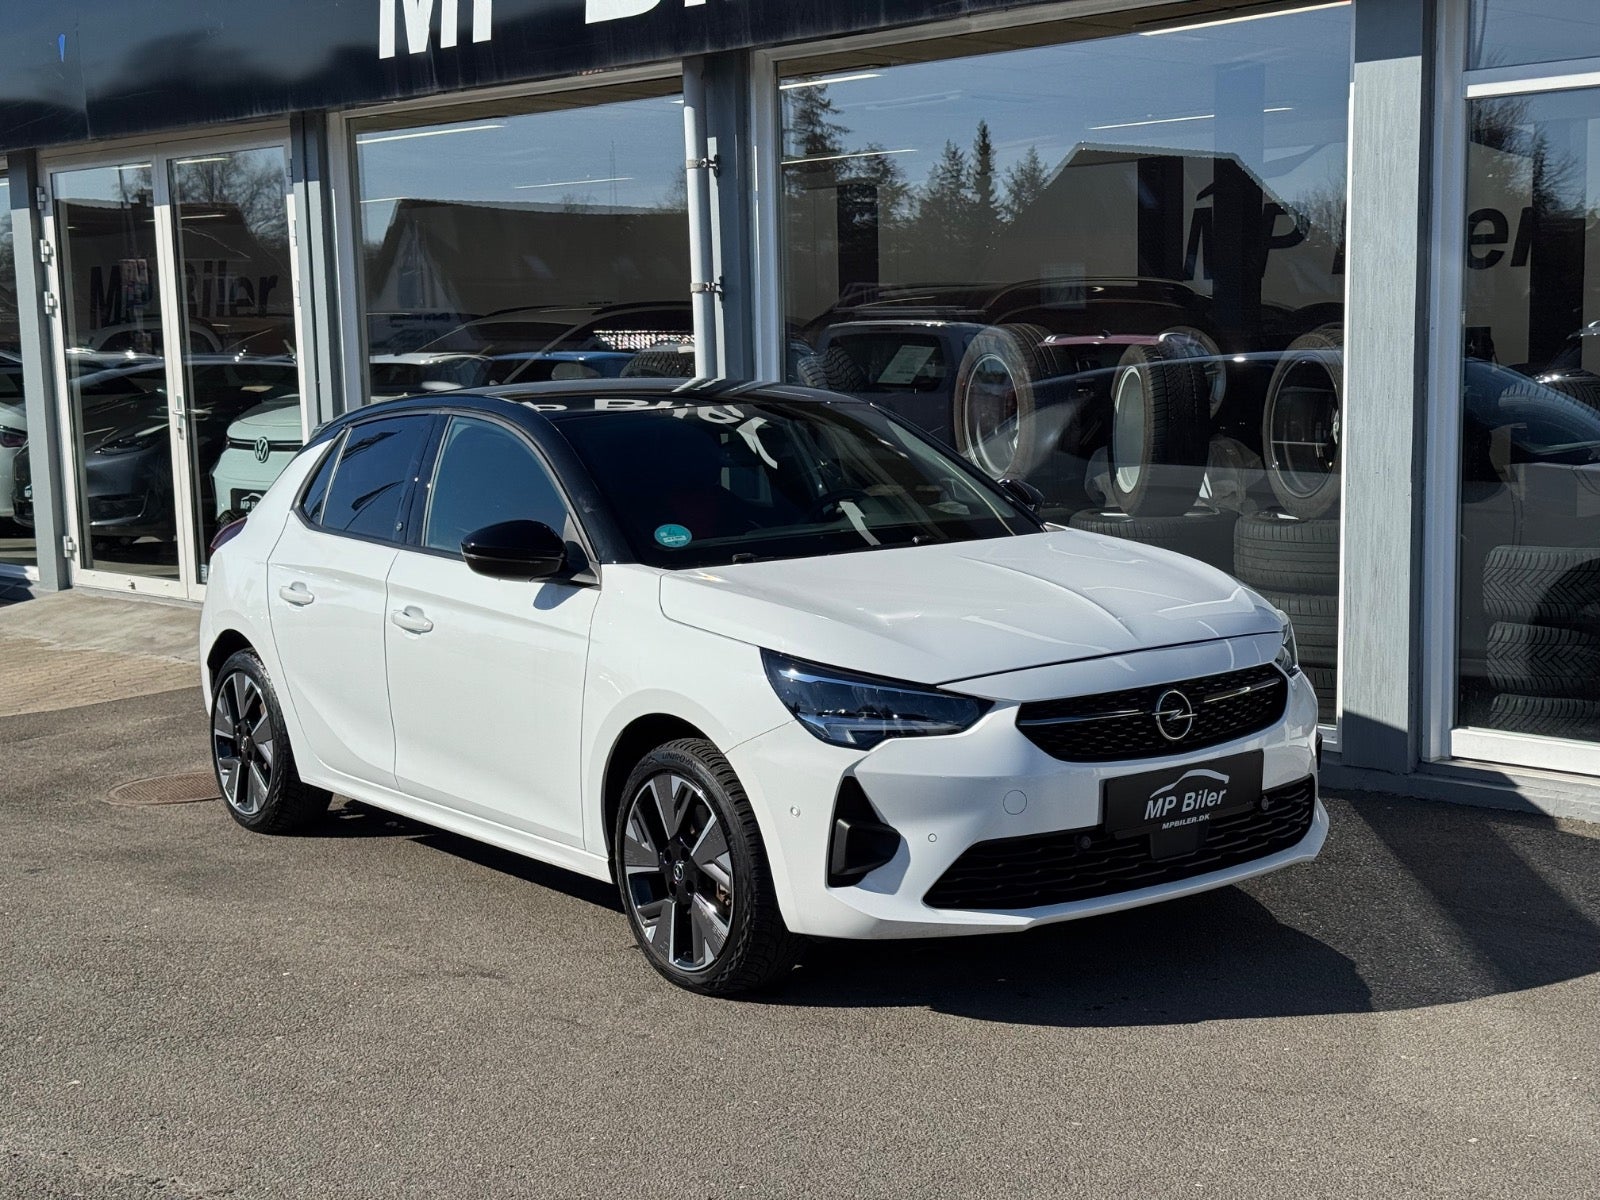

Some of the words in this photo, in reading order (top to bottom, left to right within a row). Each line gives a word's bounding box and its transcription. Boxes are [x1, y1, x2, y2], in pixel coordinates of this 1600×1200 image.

[1144, 795, 1177, 820] MP
[1181, 788, 1227, 813] Biler
[1162, 813, 1211, 830] MPBILER.DK
